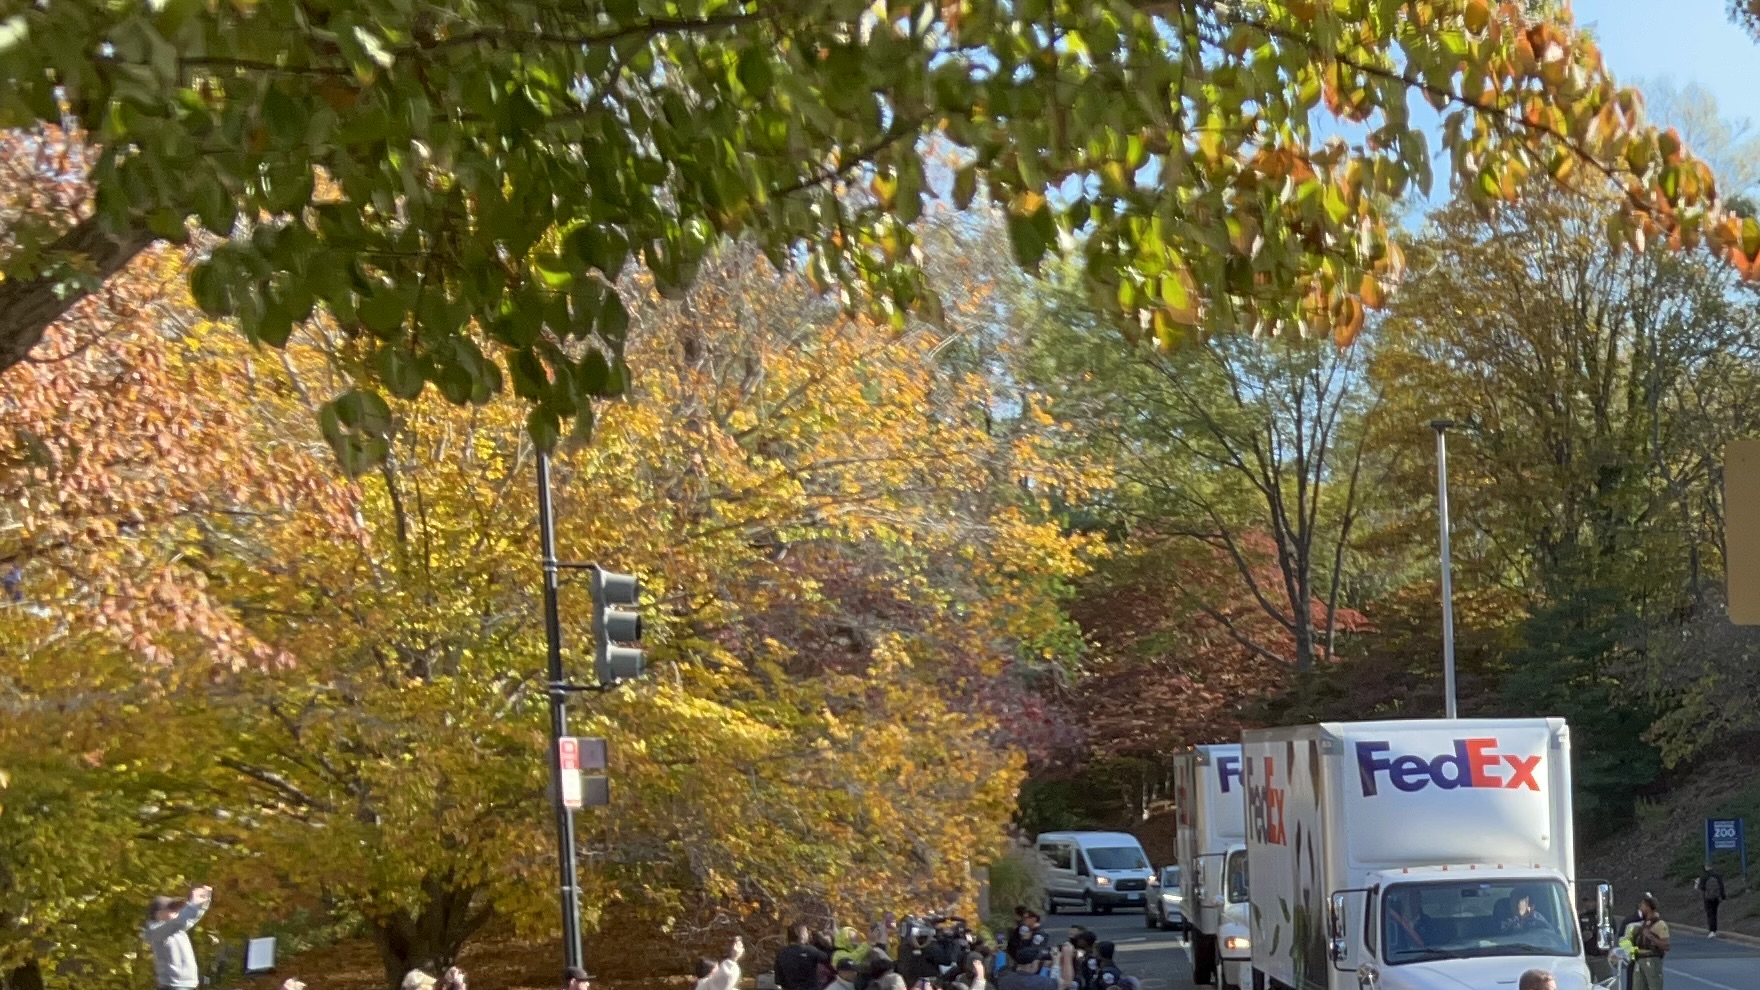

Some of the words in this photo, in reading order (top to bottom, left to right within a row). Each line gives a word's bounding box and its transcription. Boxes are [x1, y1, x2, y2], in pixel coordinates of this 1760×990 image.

[1355, 737, 1542, 798] FedEx
[1245, 756, 1287, 847] FedEx
[1714, 828, 1736, 838] ZOO
